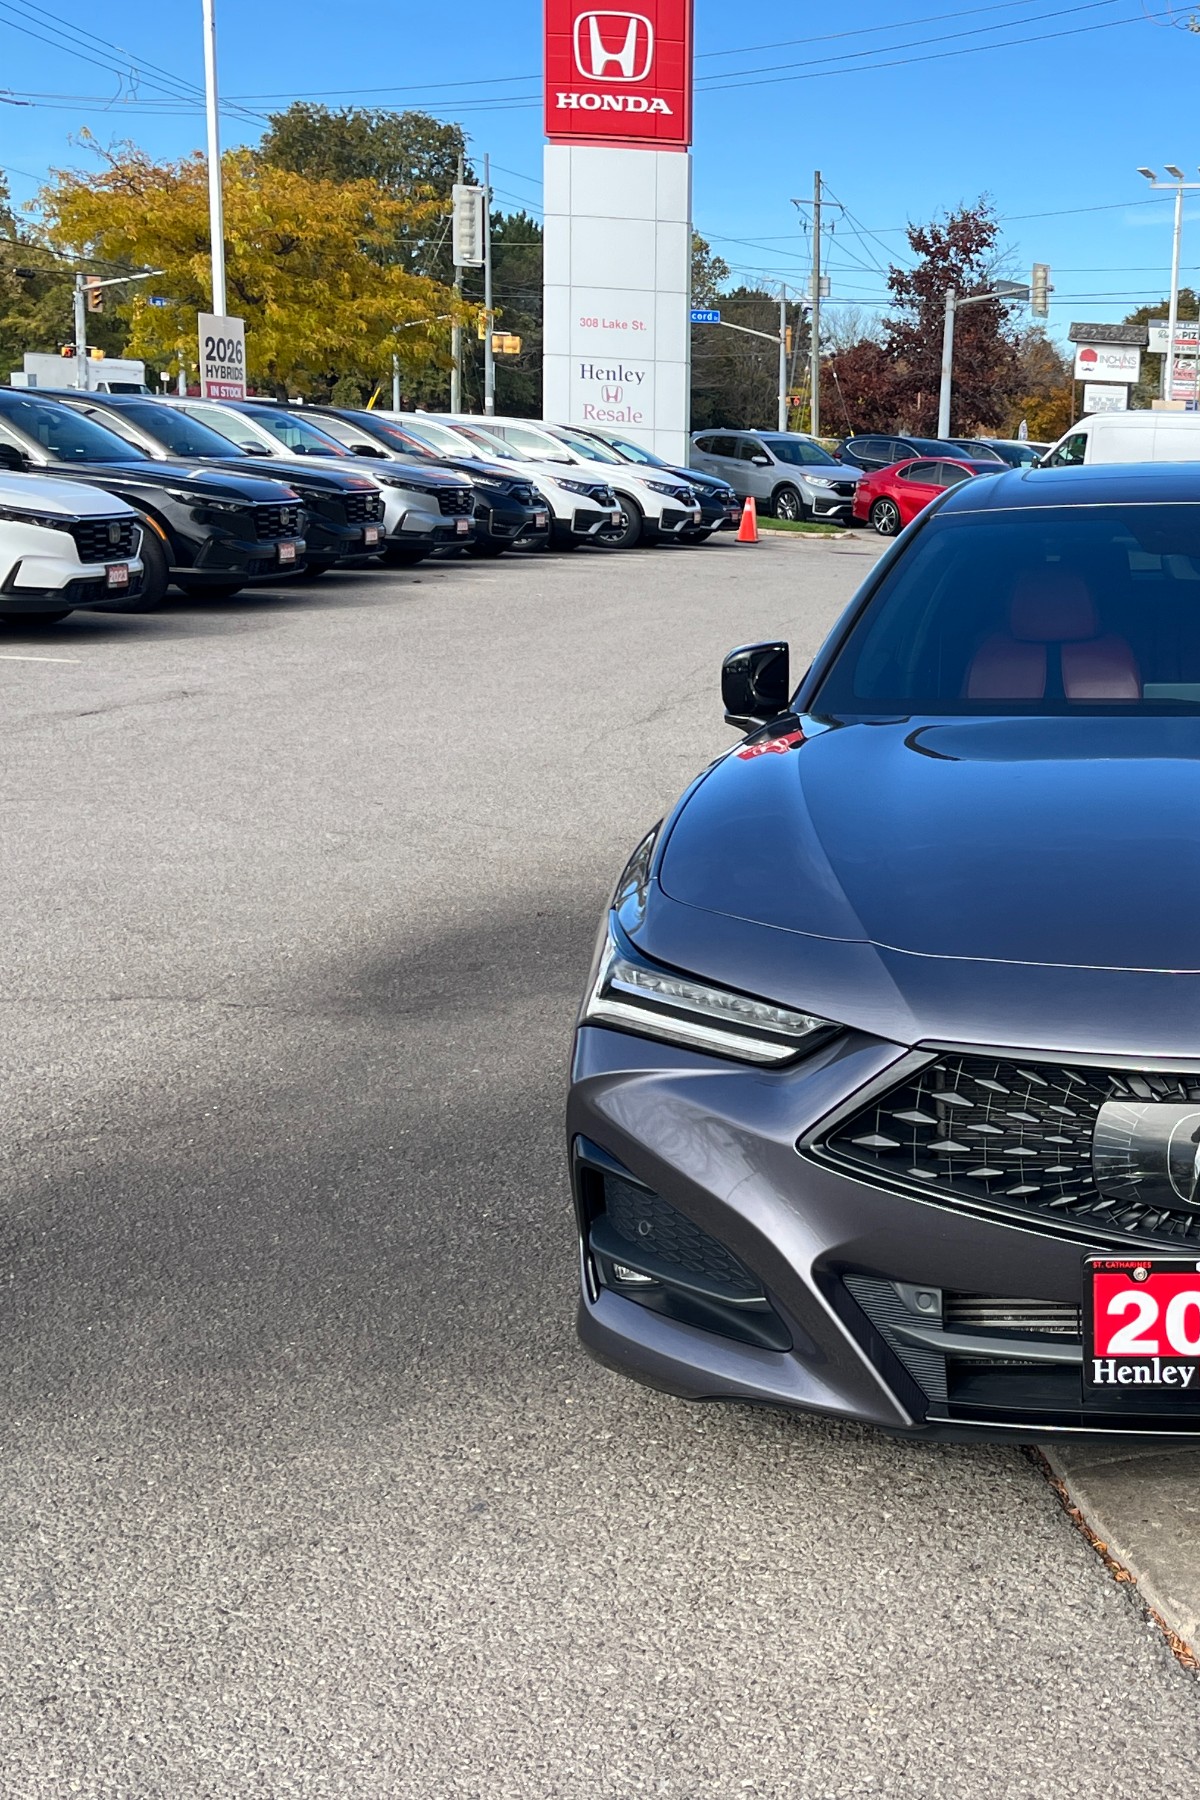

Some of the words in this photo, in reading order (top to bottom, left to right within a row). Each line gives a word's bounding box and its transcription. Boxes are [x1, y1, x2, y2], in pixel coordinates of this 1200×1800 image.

[555, 92, 674, 115] HONDA
[579, 317, 599, 329] 308
[602, 318, 628, 330] Lake
[631, 320, 647, 331] St.
[205, 336, 243, 365] 2026
[205, 364, 243, 380] HYBRIDS
[579, 363, 646, 385] Henley
[210, 385, 219, 397] IN
[220, 386, 242, 398] STOCK
[582, 403, 643, 424] Resale
[1092, 1261, 1104, 1269] ST.
[1105, 1261, 1152, 1269] CATHARINES
[1092, 1358, 1196, 1388] Henley
